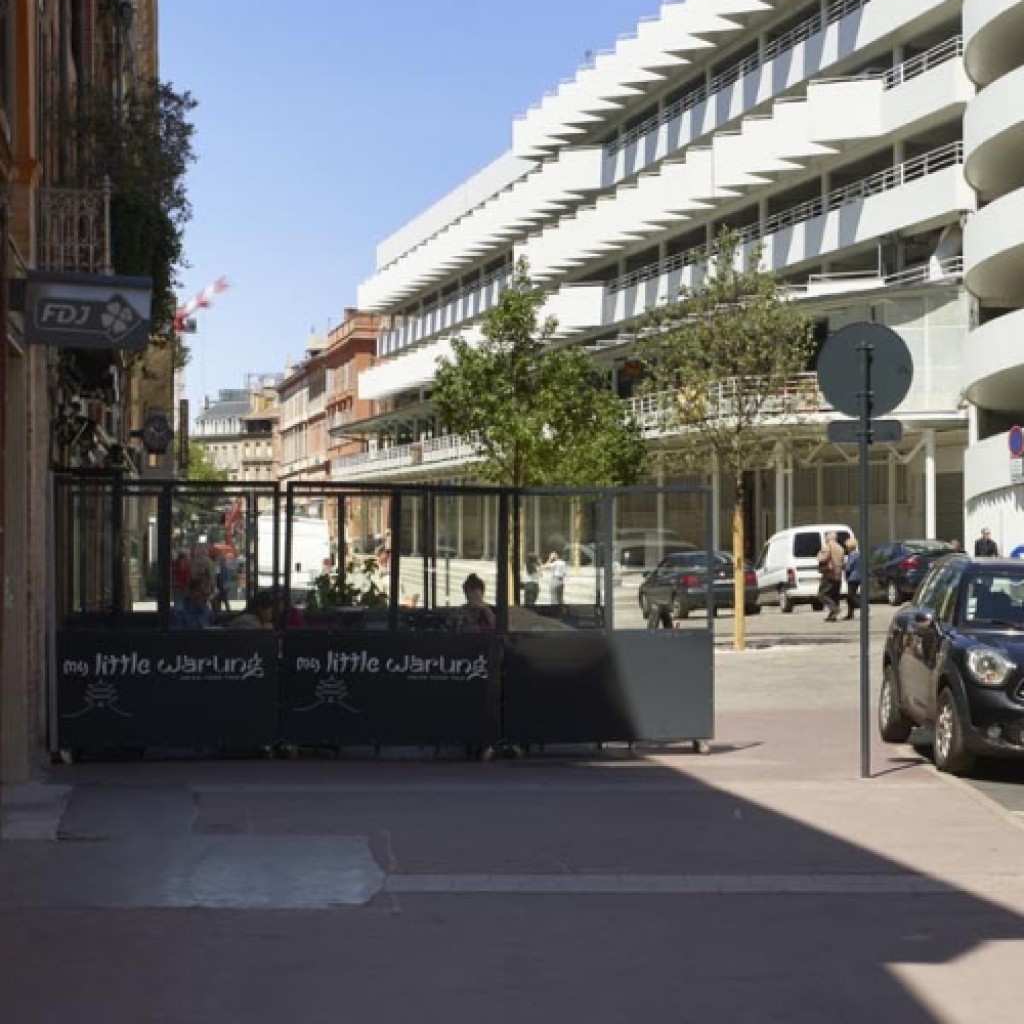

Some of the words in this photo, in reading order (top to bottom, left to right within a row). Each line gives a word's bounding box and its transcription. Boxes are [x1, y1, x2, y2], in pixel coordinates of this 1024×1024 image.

[41, 303, 91, 325] FDJ
[63, 659, 89, 676] my
[95, 652, 150, 675] little
[157, 651, 265, 680] warung
[296, 656, 320, 673] my
[326, 650, 380, 673] little
[385, 654, 488, 680] warung
